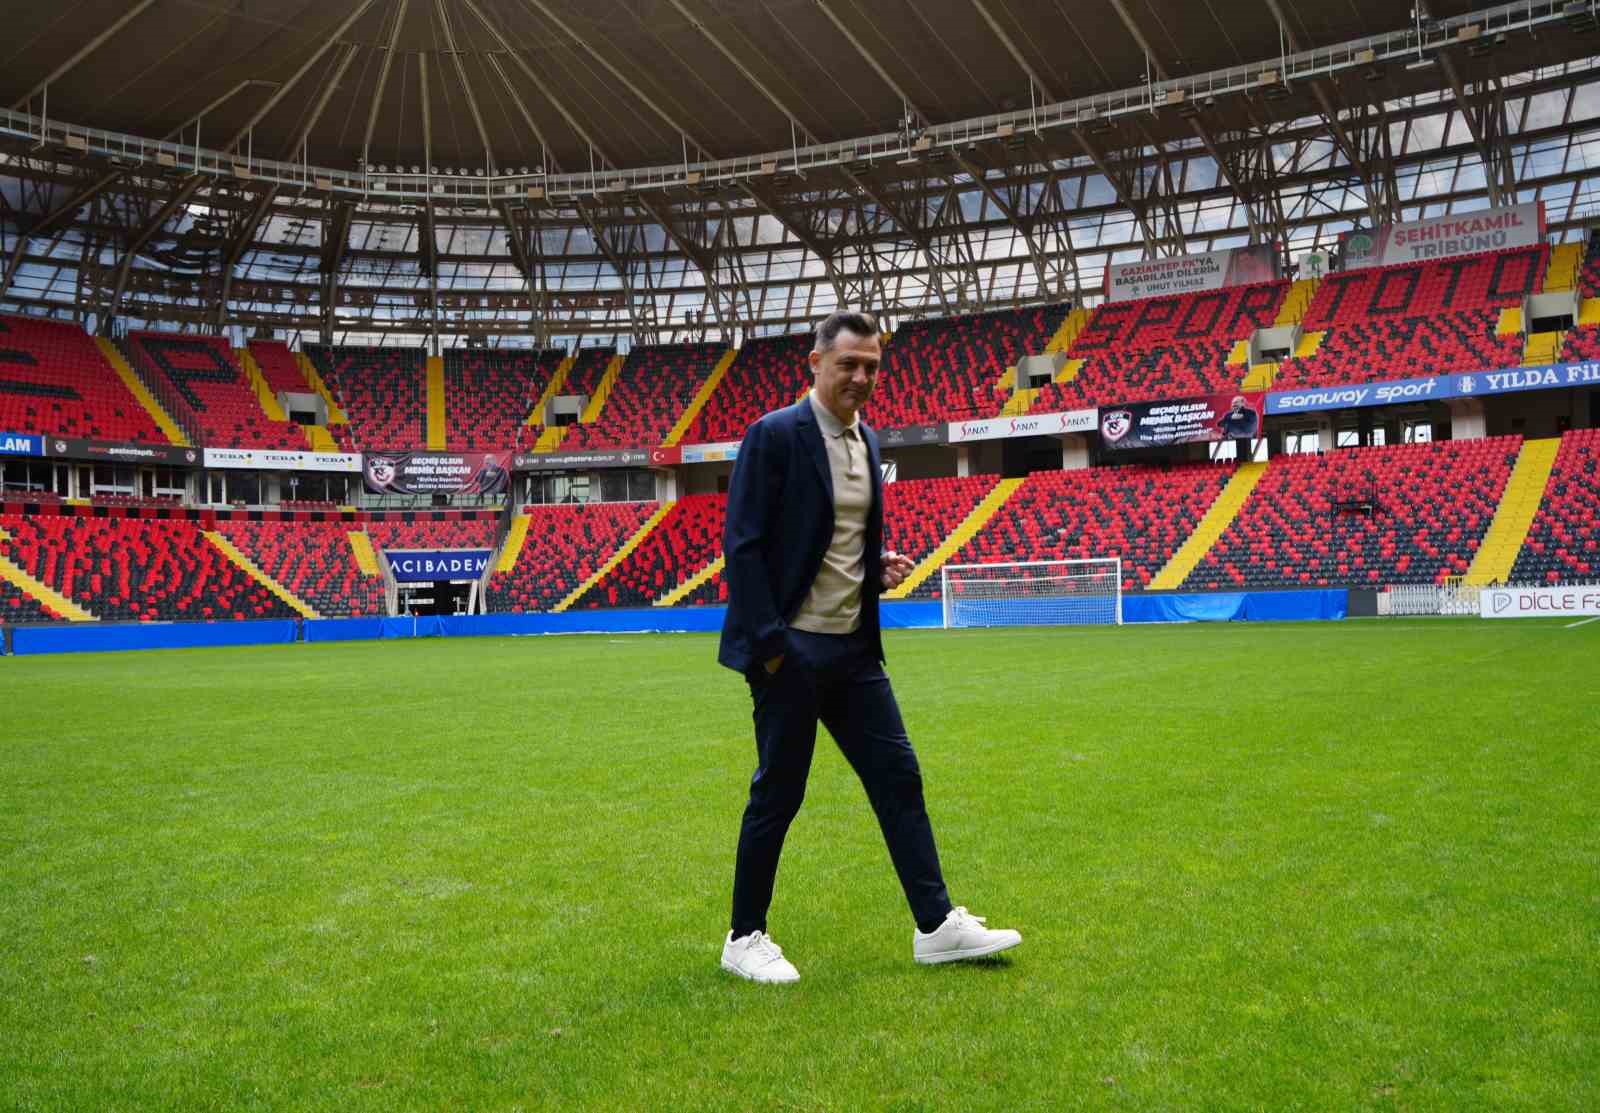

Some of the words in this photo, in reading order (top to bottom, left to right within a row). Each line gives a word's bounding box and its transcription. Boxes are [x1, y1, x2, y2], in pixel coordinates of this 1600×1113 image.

[1411, 230, 1506, 258] TRİBÜNÜ
[1486, 369, 1559, 389] YILDA
[1278, 388, 1368, 408] samuray
[1376, 378, 1436, 400] sport
[391, 558, 487, 573] ACIBADEM
